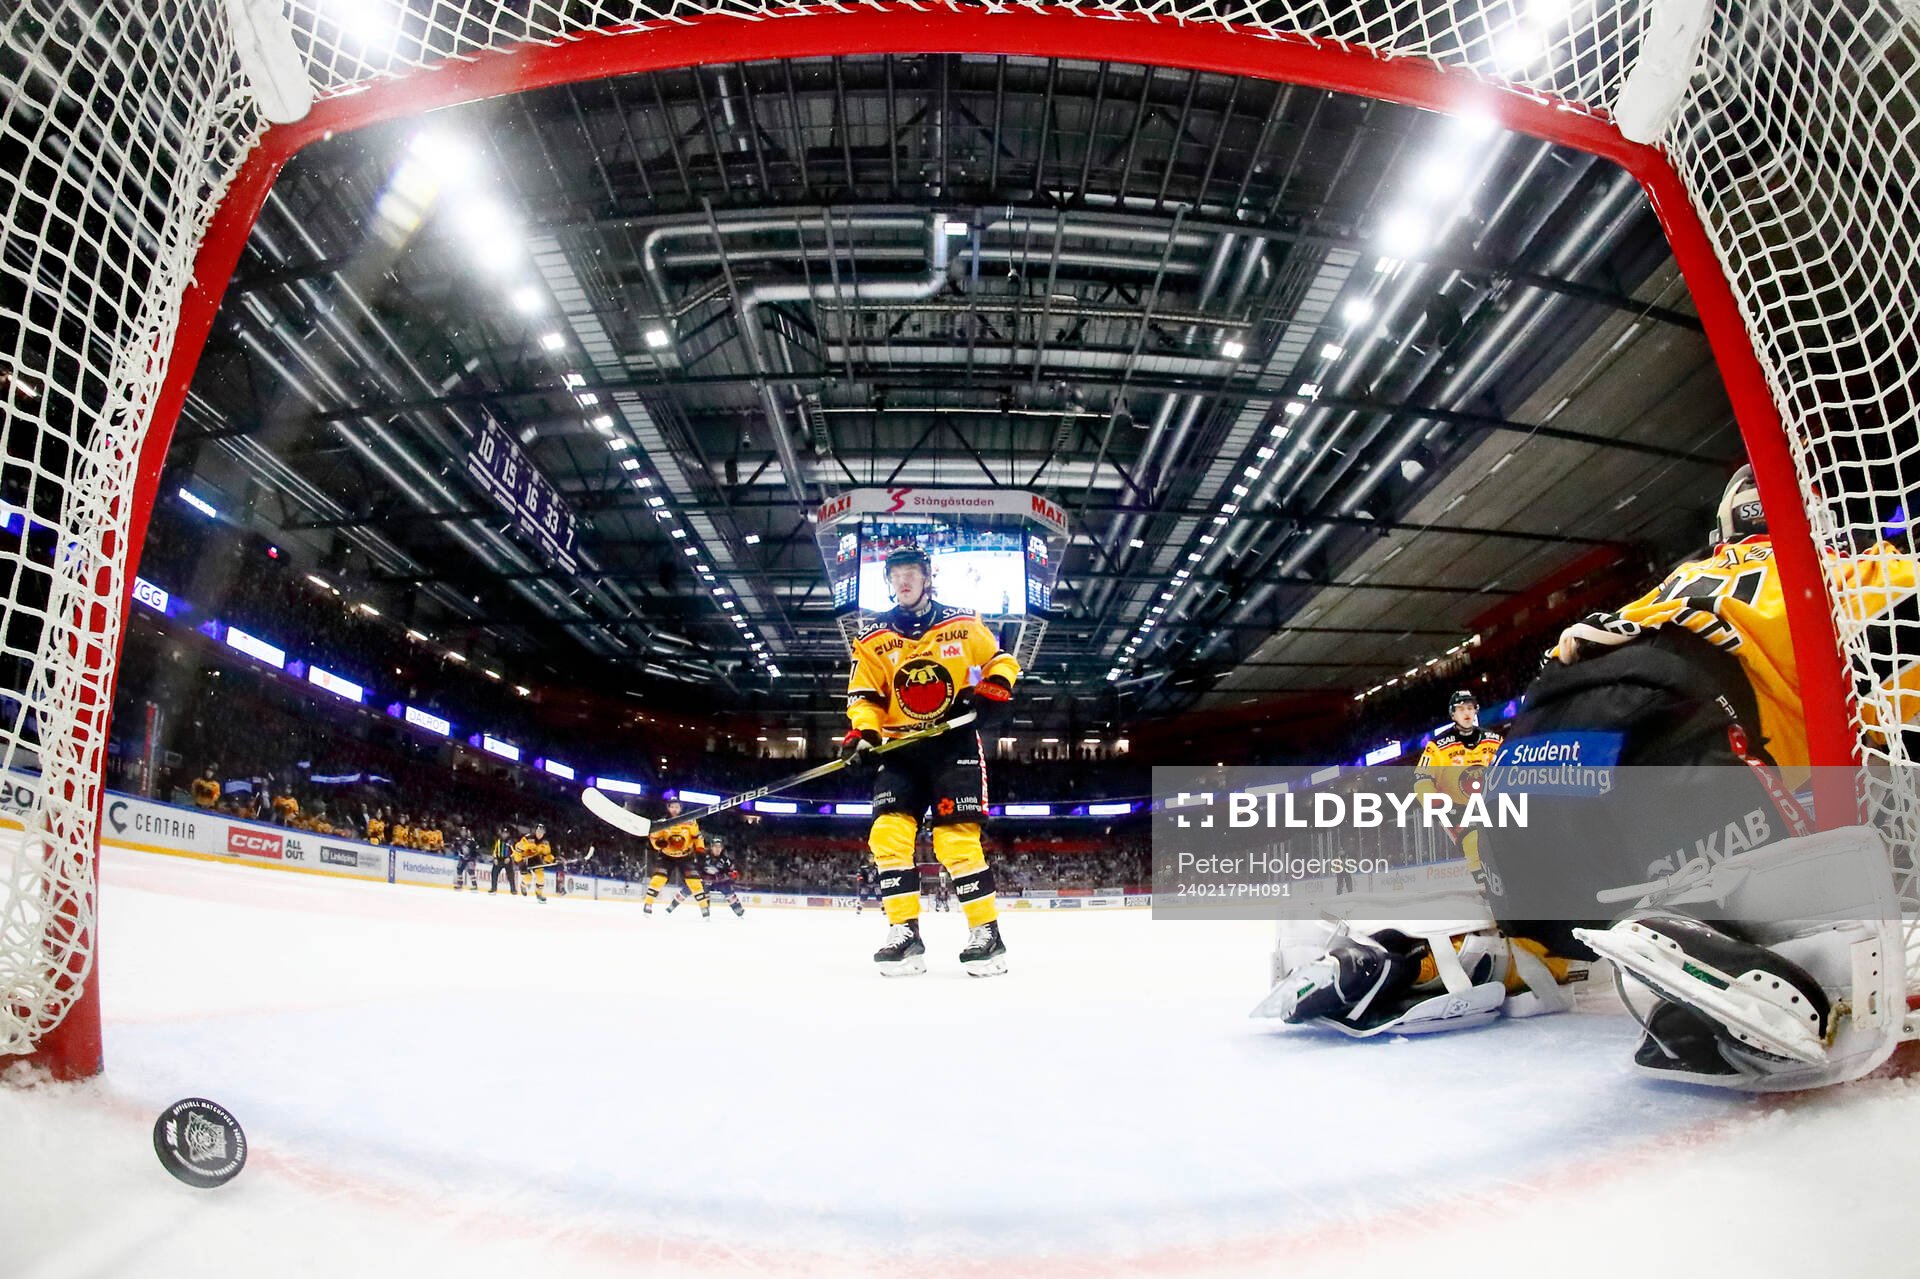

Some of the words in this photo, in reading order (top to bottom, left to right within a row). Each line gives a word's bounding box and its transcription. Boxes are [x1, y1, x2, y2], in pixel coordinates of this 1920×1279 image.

[478, 430, 495, 464] 10
[525, 483, 539, 513] 16
[544, 504, 559, 534] 33
[566, 528, 574, 550] 7
[914, 497, 994, 507] Stångåstaden
[818, 496, 851, 522] MAXI
[1032, 495, 1066, 528] MAXI
[942, 608, 974, 618] SSAB
[1436, 736, 1456, 748] SSAB
[1512, 740, 1580, 764] Student
[1507, 763, 1611, 795] Consulting
[135, 813, 195, 840] CENTRIA
[230, 834, 281, 853] CCM
[286, 838, 302, 850] ALL
